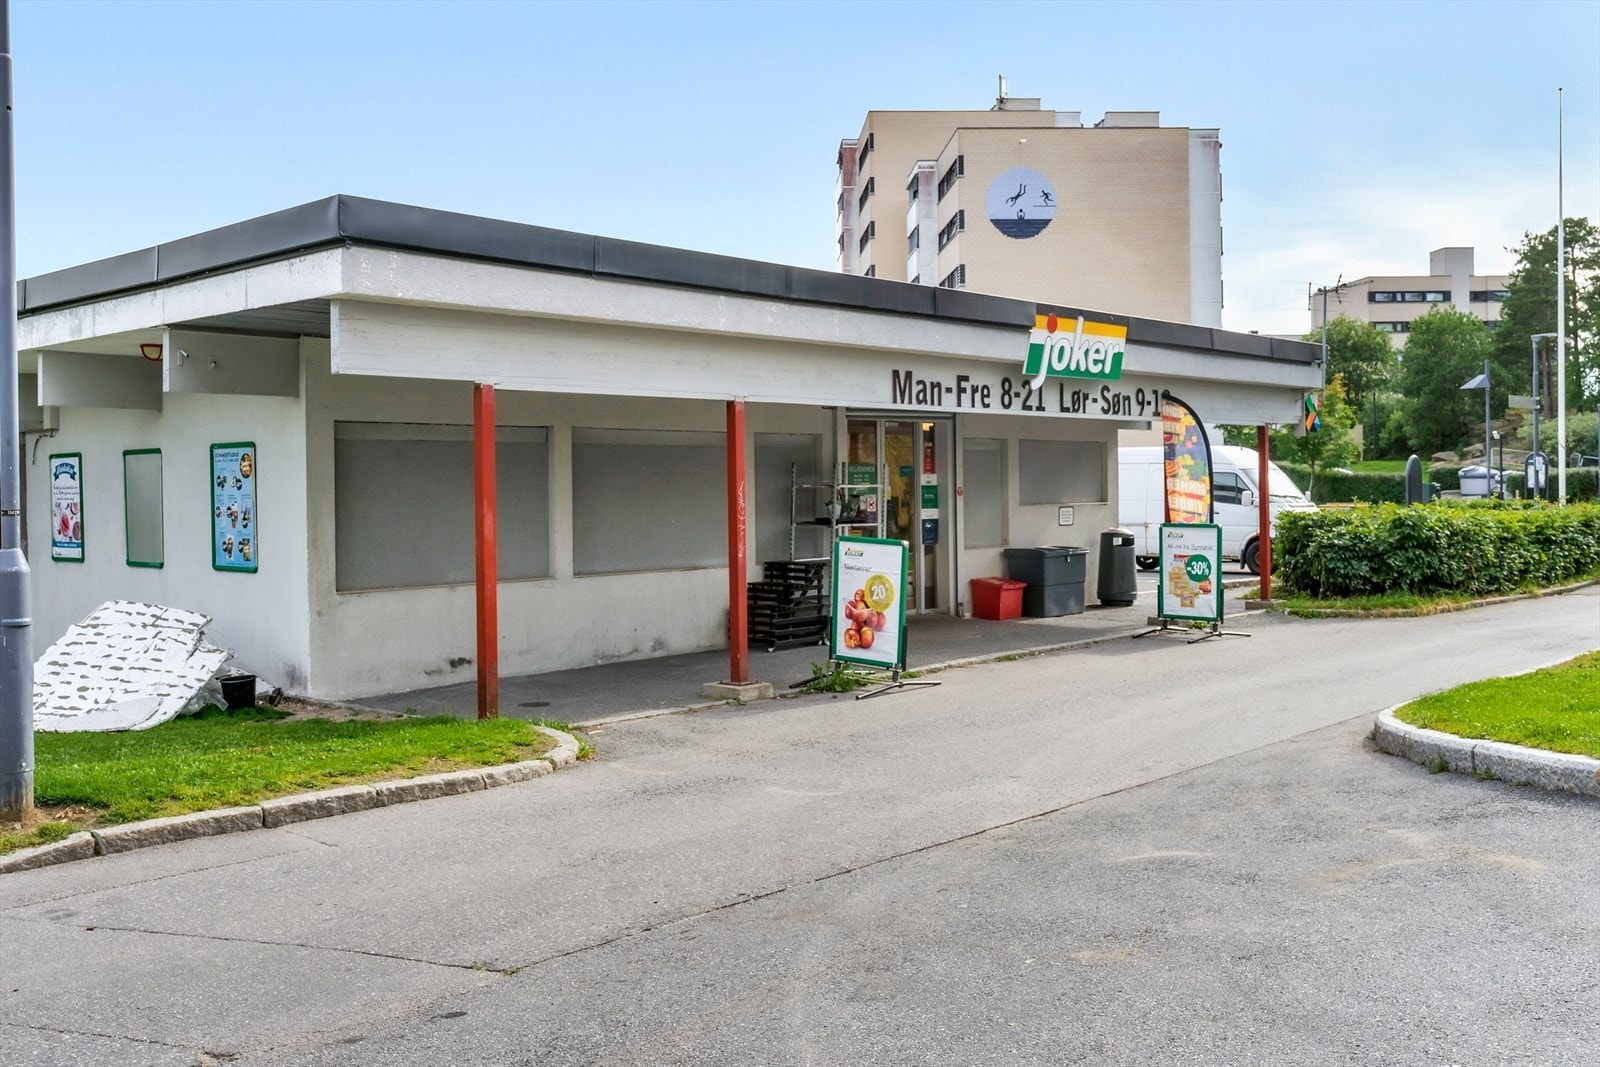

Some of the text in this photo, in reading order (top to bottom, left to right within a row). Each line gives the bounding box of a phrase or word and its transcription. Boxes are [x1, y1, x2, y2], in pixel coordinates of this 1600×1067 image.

[1030, 313, 1121, 391] joker
[892, 369, 1170, 417] Man-Fre 8-21 Lør-Søn 9-1
[1187, 561, 1209, 576] -30%
